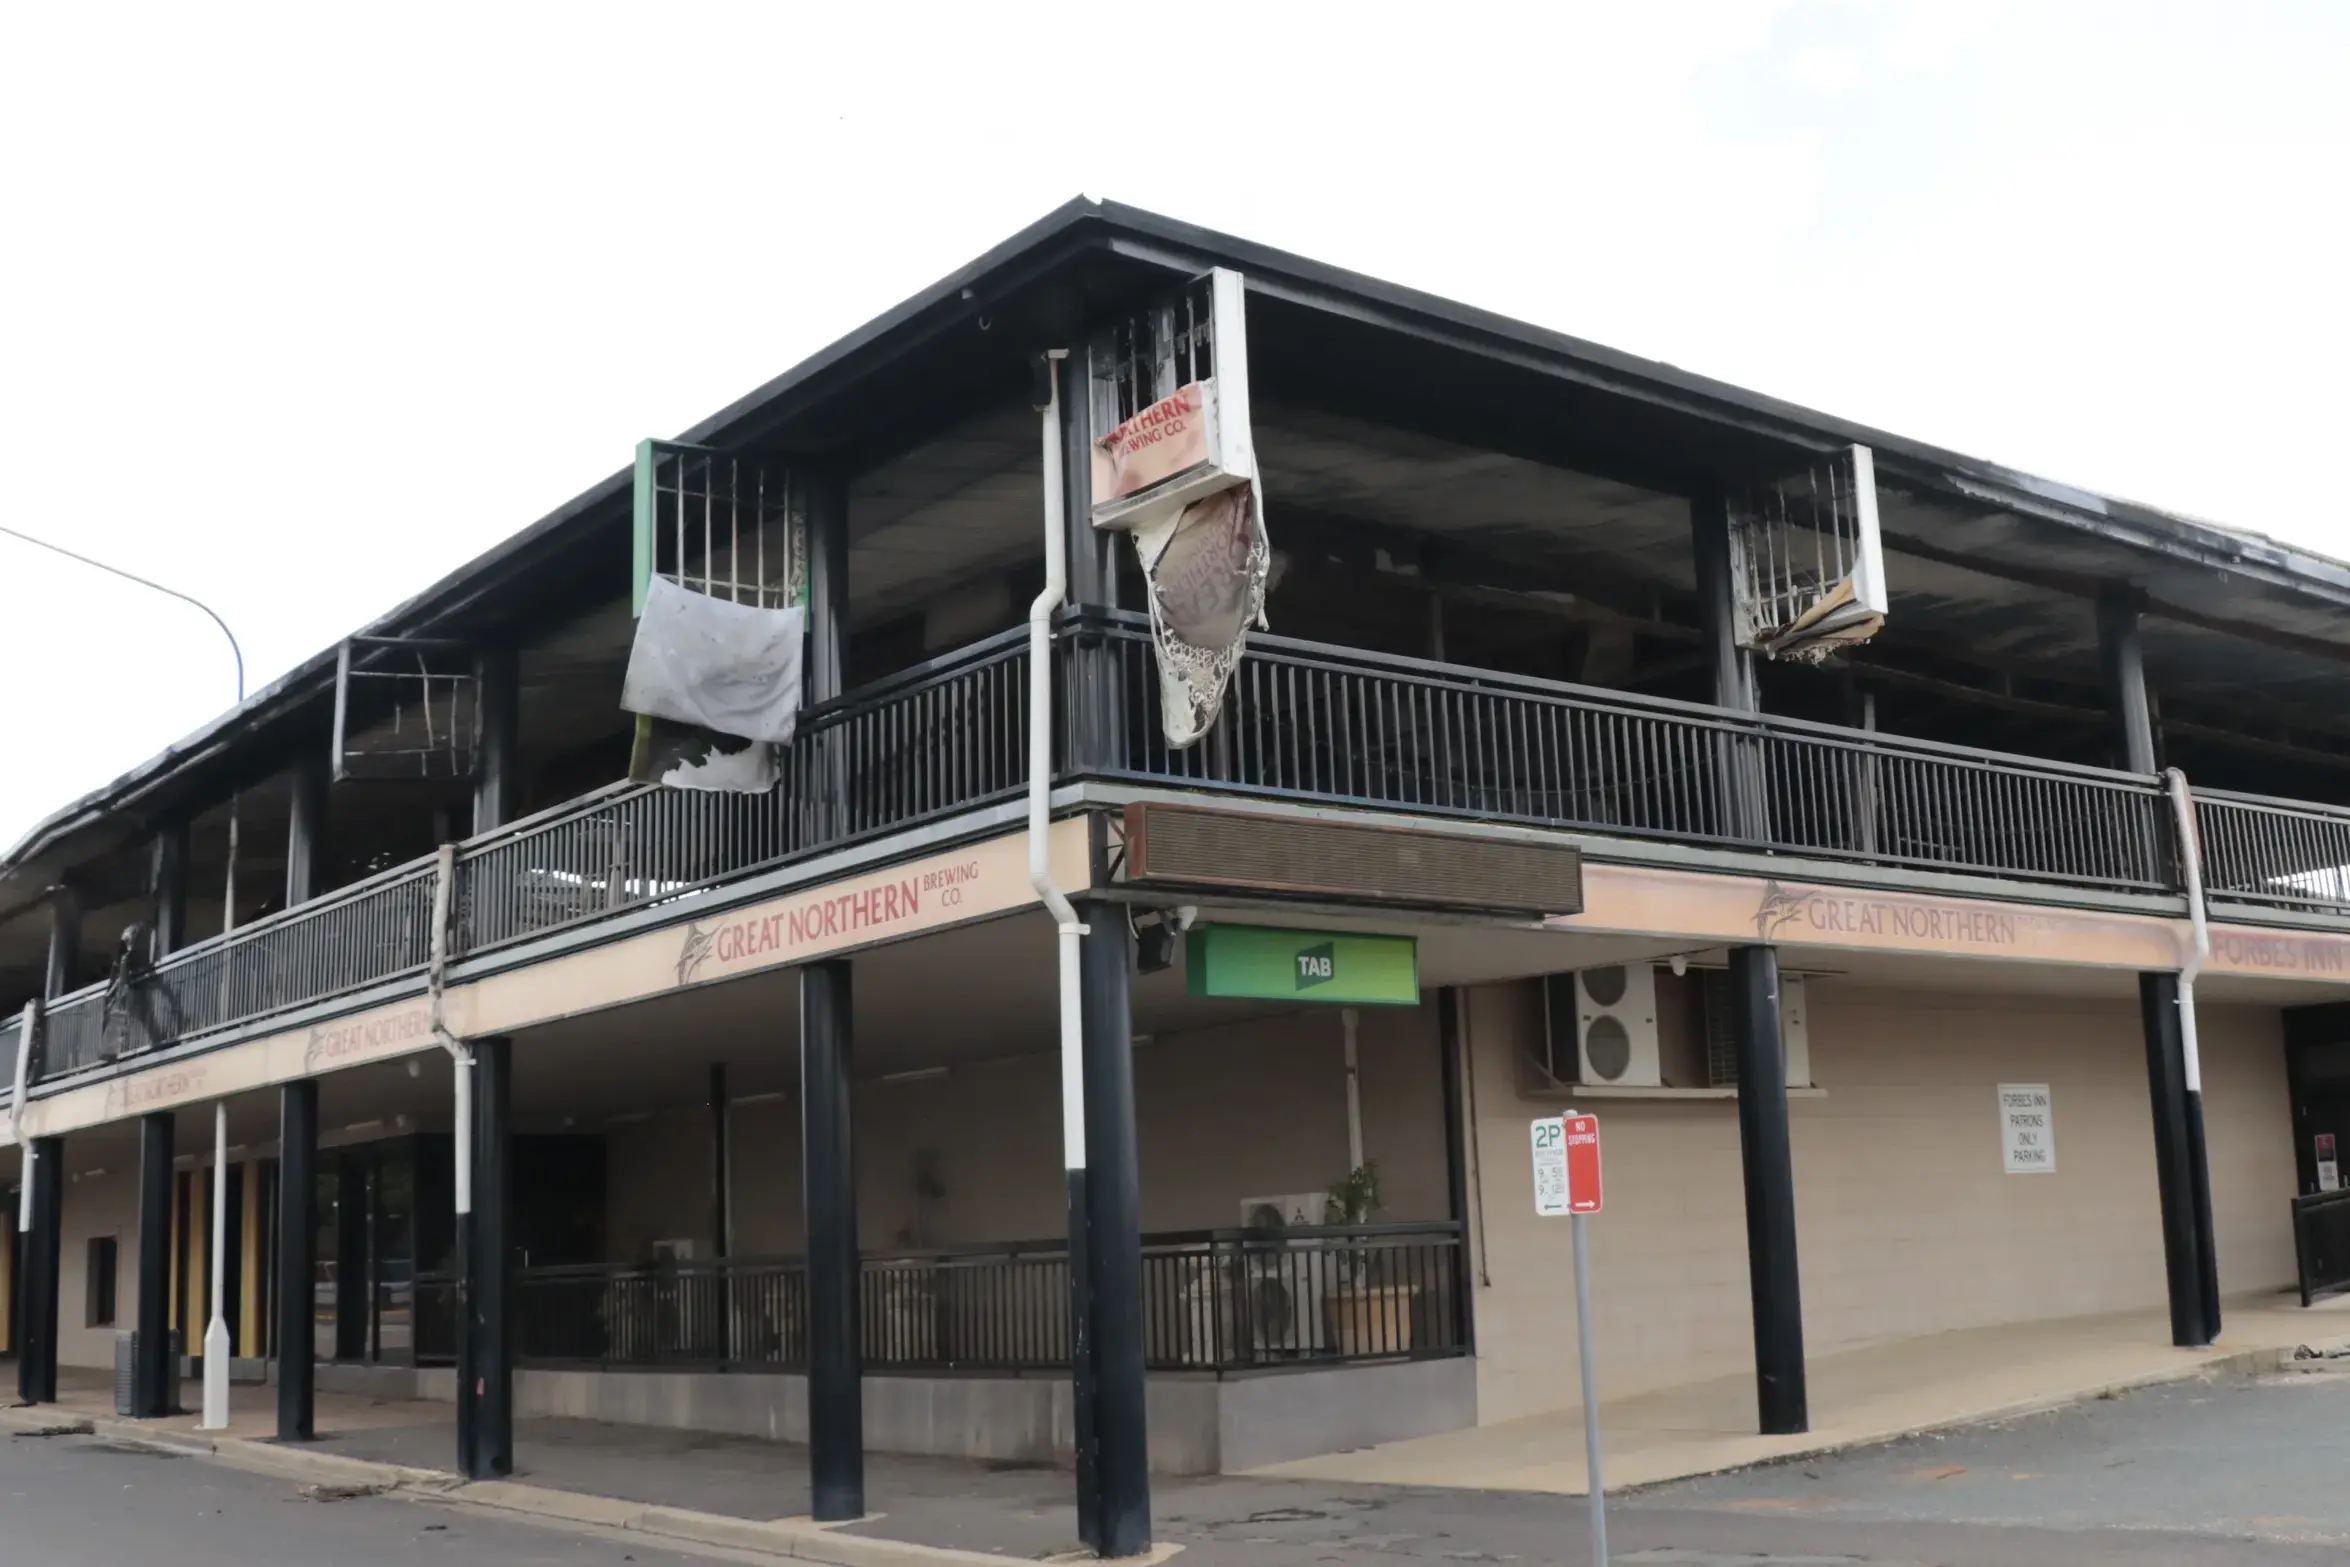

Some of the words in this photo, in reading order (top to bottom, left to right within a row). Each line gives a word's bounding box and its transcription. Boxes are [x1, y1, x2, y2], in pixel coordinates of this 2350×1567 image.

[923, 861, 979, 891] BREWING
[717, 912, 784, 962] GREAT
[789, 877, 920, 945] NORTHERN
[1808, 898, 1886, 934] GREAT
[1893, 906, 2016, 944] NORTHERN
[2211, 929, 2298, 970] FORBES
[2304, 940, 2343, 972] INN
[1298, 956, 1331, 976] TAB
[1575, 1121, 1586, 1132] NO
[2010, 1114, 2044, 1128] PATRONS
[1535, 1124, 1561, 1148] 2P
[1568, 1133, 1596, 1146] STOPPING
[2018, 1131, 2037, 1145] ONLY
[2013, 1149, 2047, 1163] PARKING
